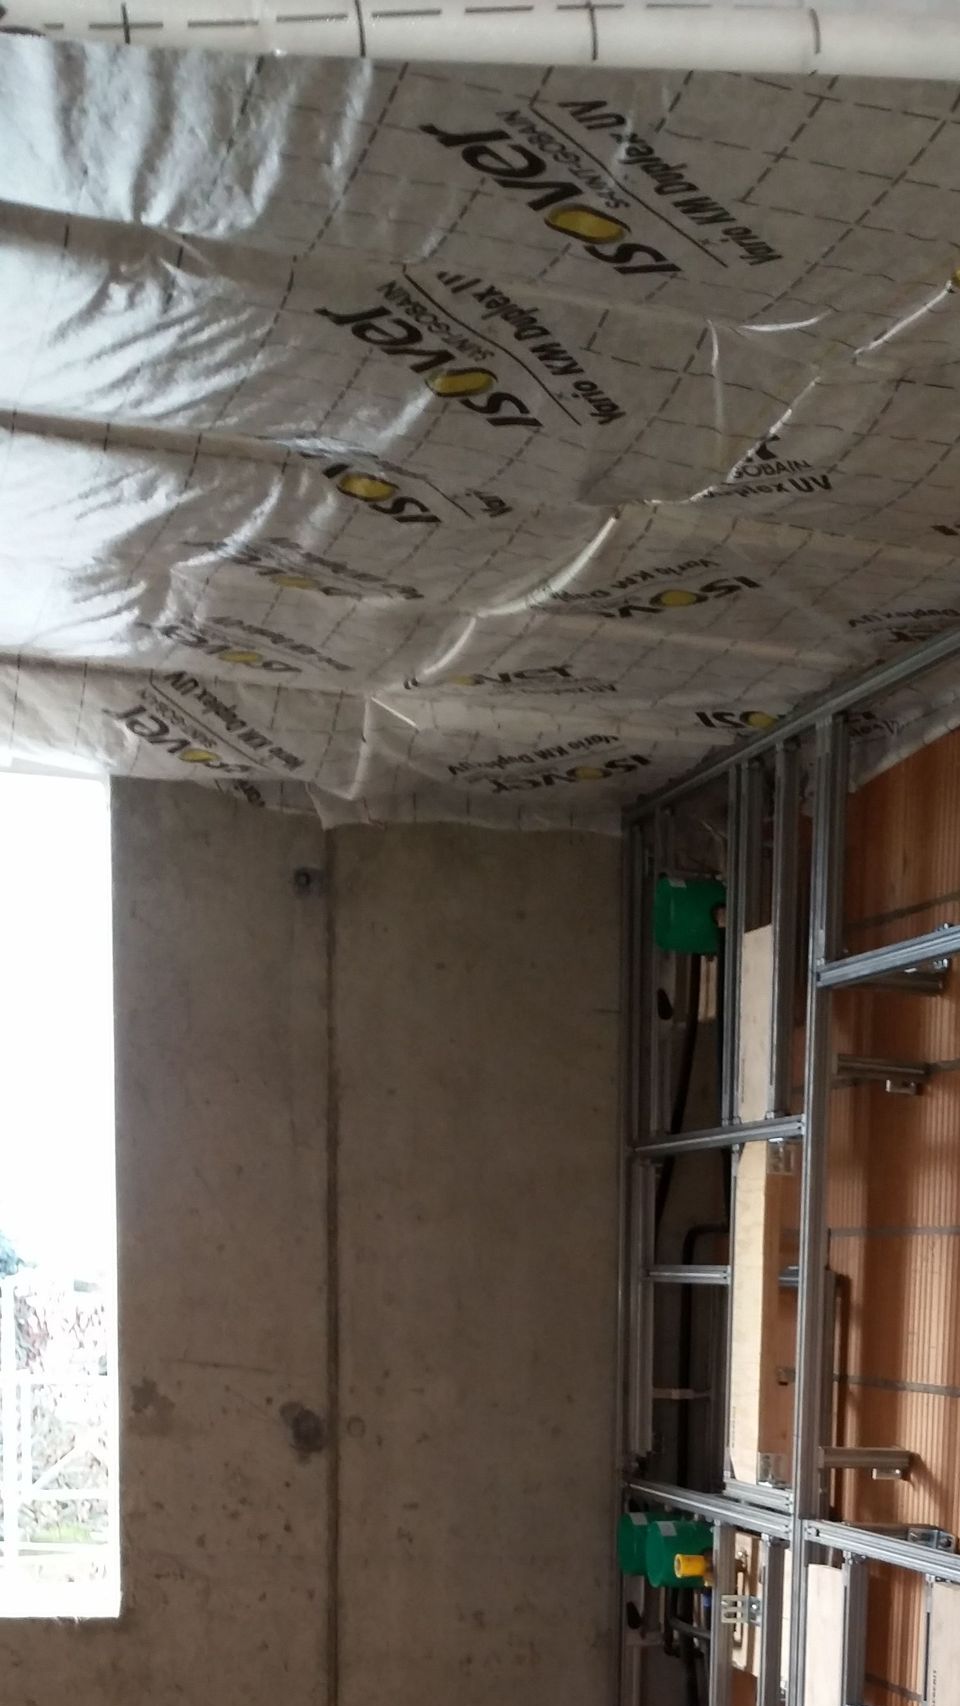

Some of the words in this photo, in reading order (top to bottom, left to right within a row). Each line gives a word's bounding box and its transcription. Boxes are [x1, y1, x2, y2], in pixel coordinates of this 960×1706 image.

[558, 100, 627, 131] UV
[672, 195, 736, 227] KM
[530, 342, 585, 377] KM
[788, 474, 833, 494] UV
